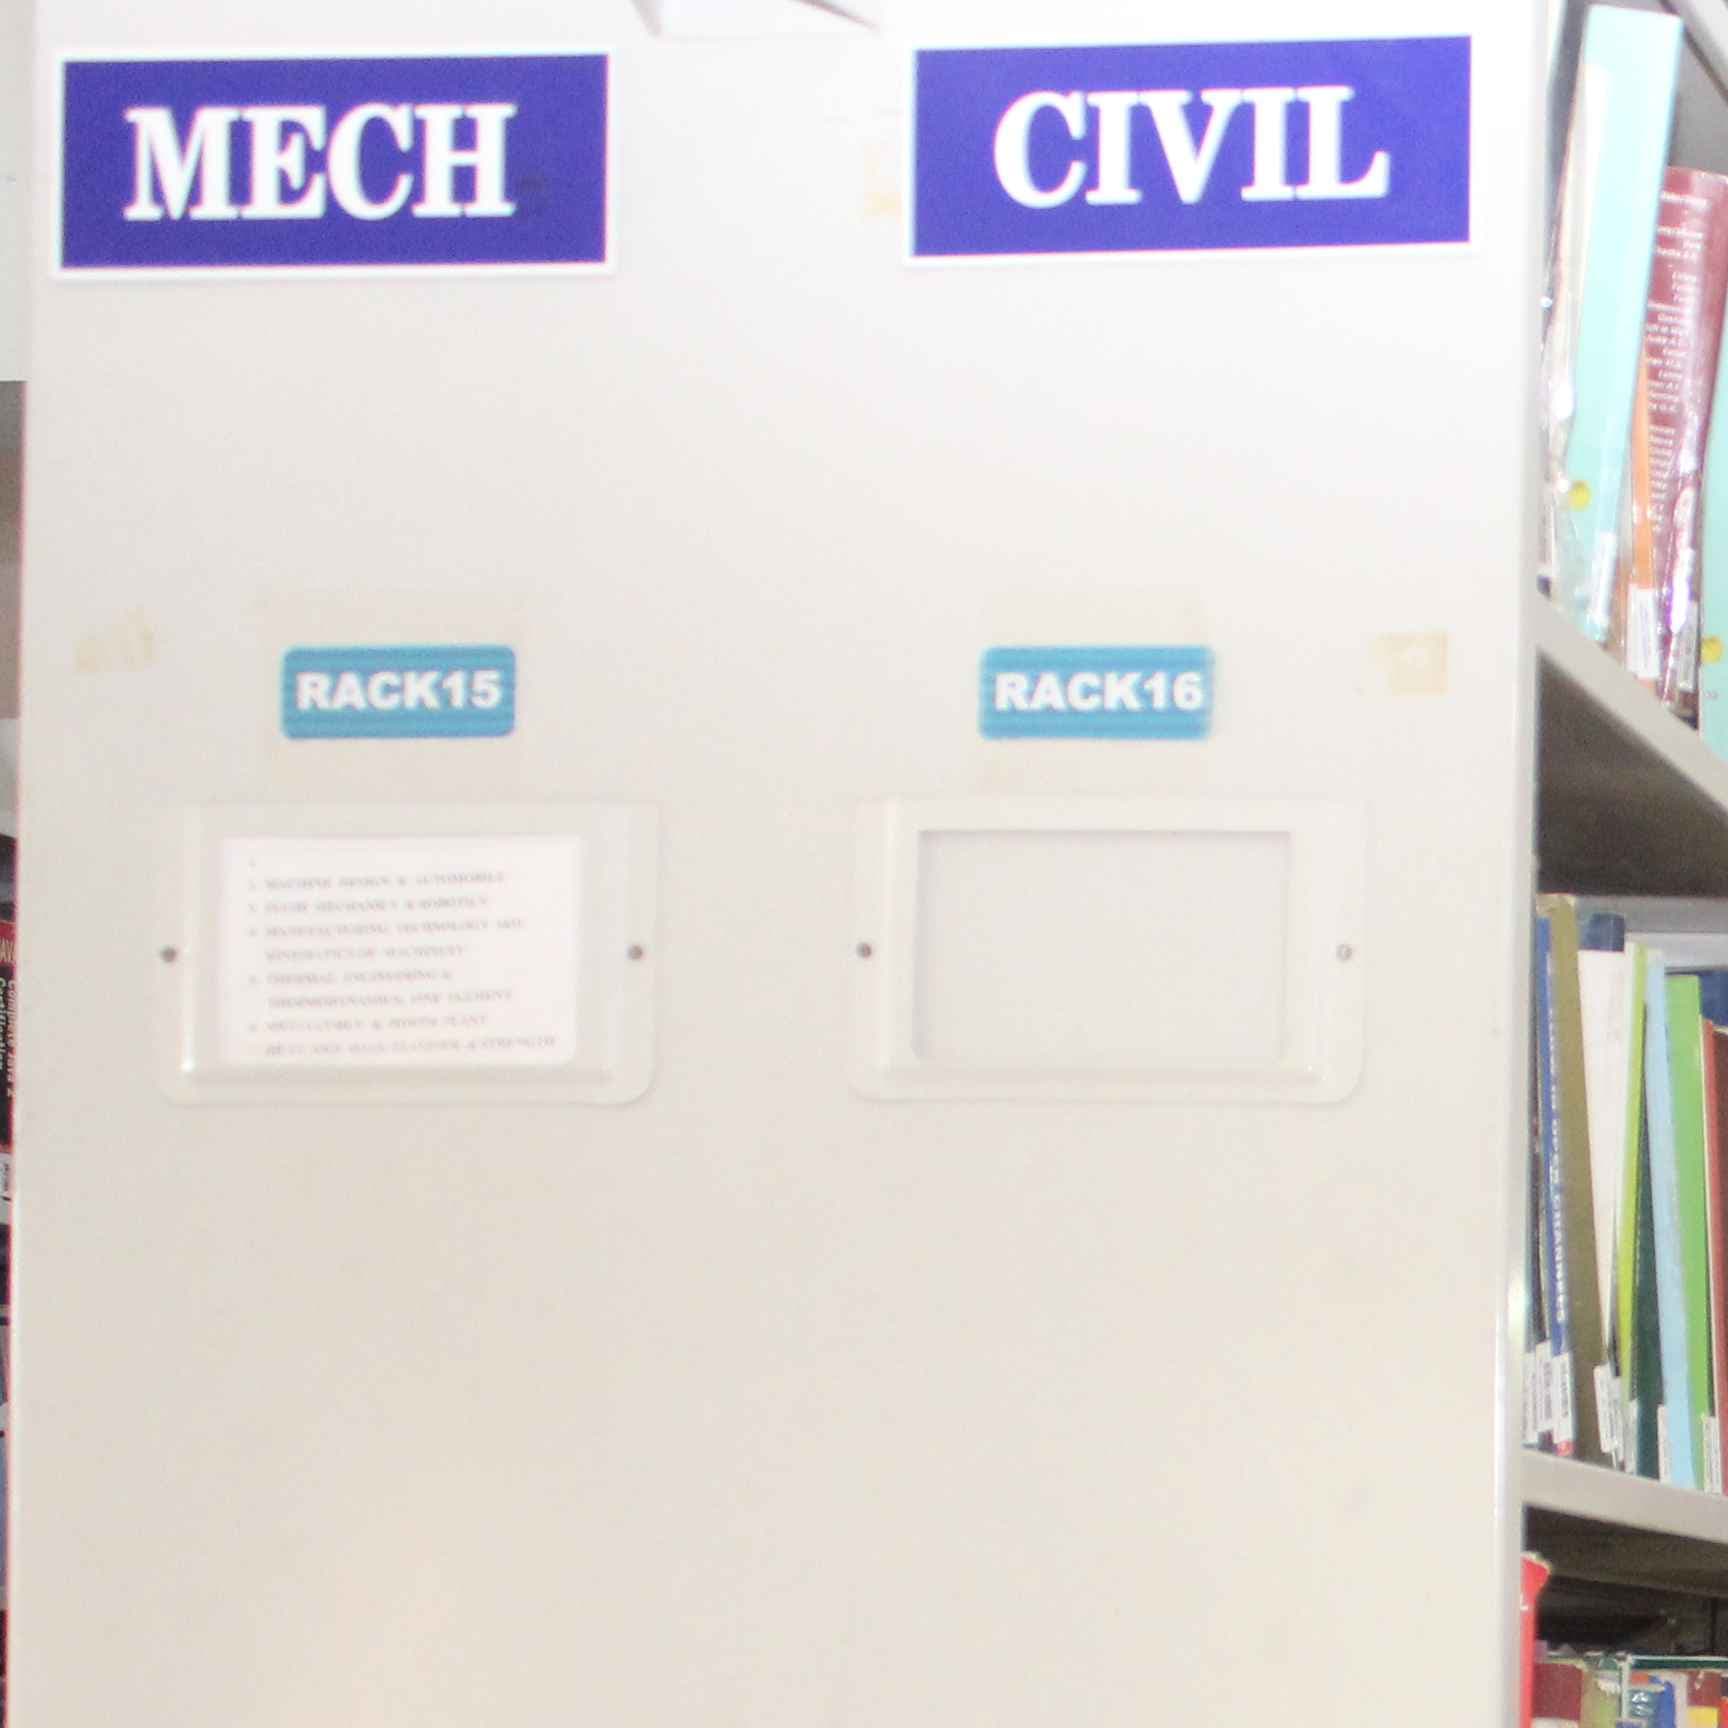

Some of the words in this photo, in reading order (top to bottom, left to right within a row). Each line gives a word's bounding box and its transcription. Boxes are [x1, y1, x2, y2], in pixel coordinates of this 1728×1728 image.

[124, 102, 517, 222] MECH
[993, 85, 1391, 210] CIVIL
[295, 672, 503, 711] RACK15
[994, 671, 1204, 711] RACK16
